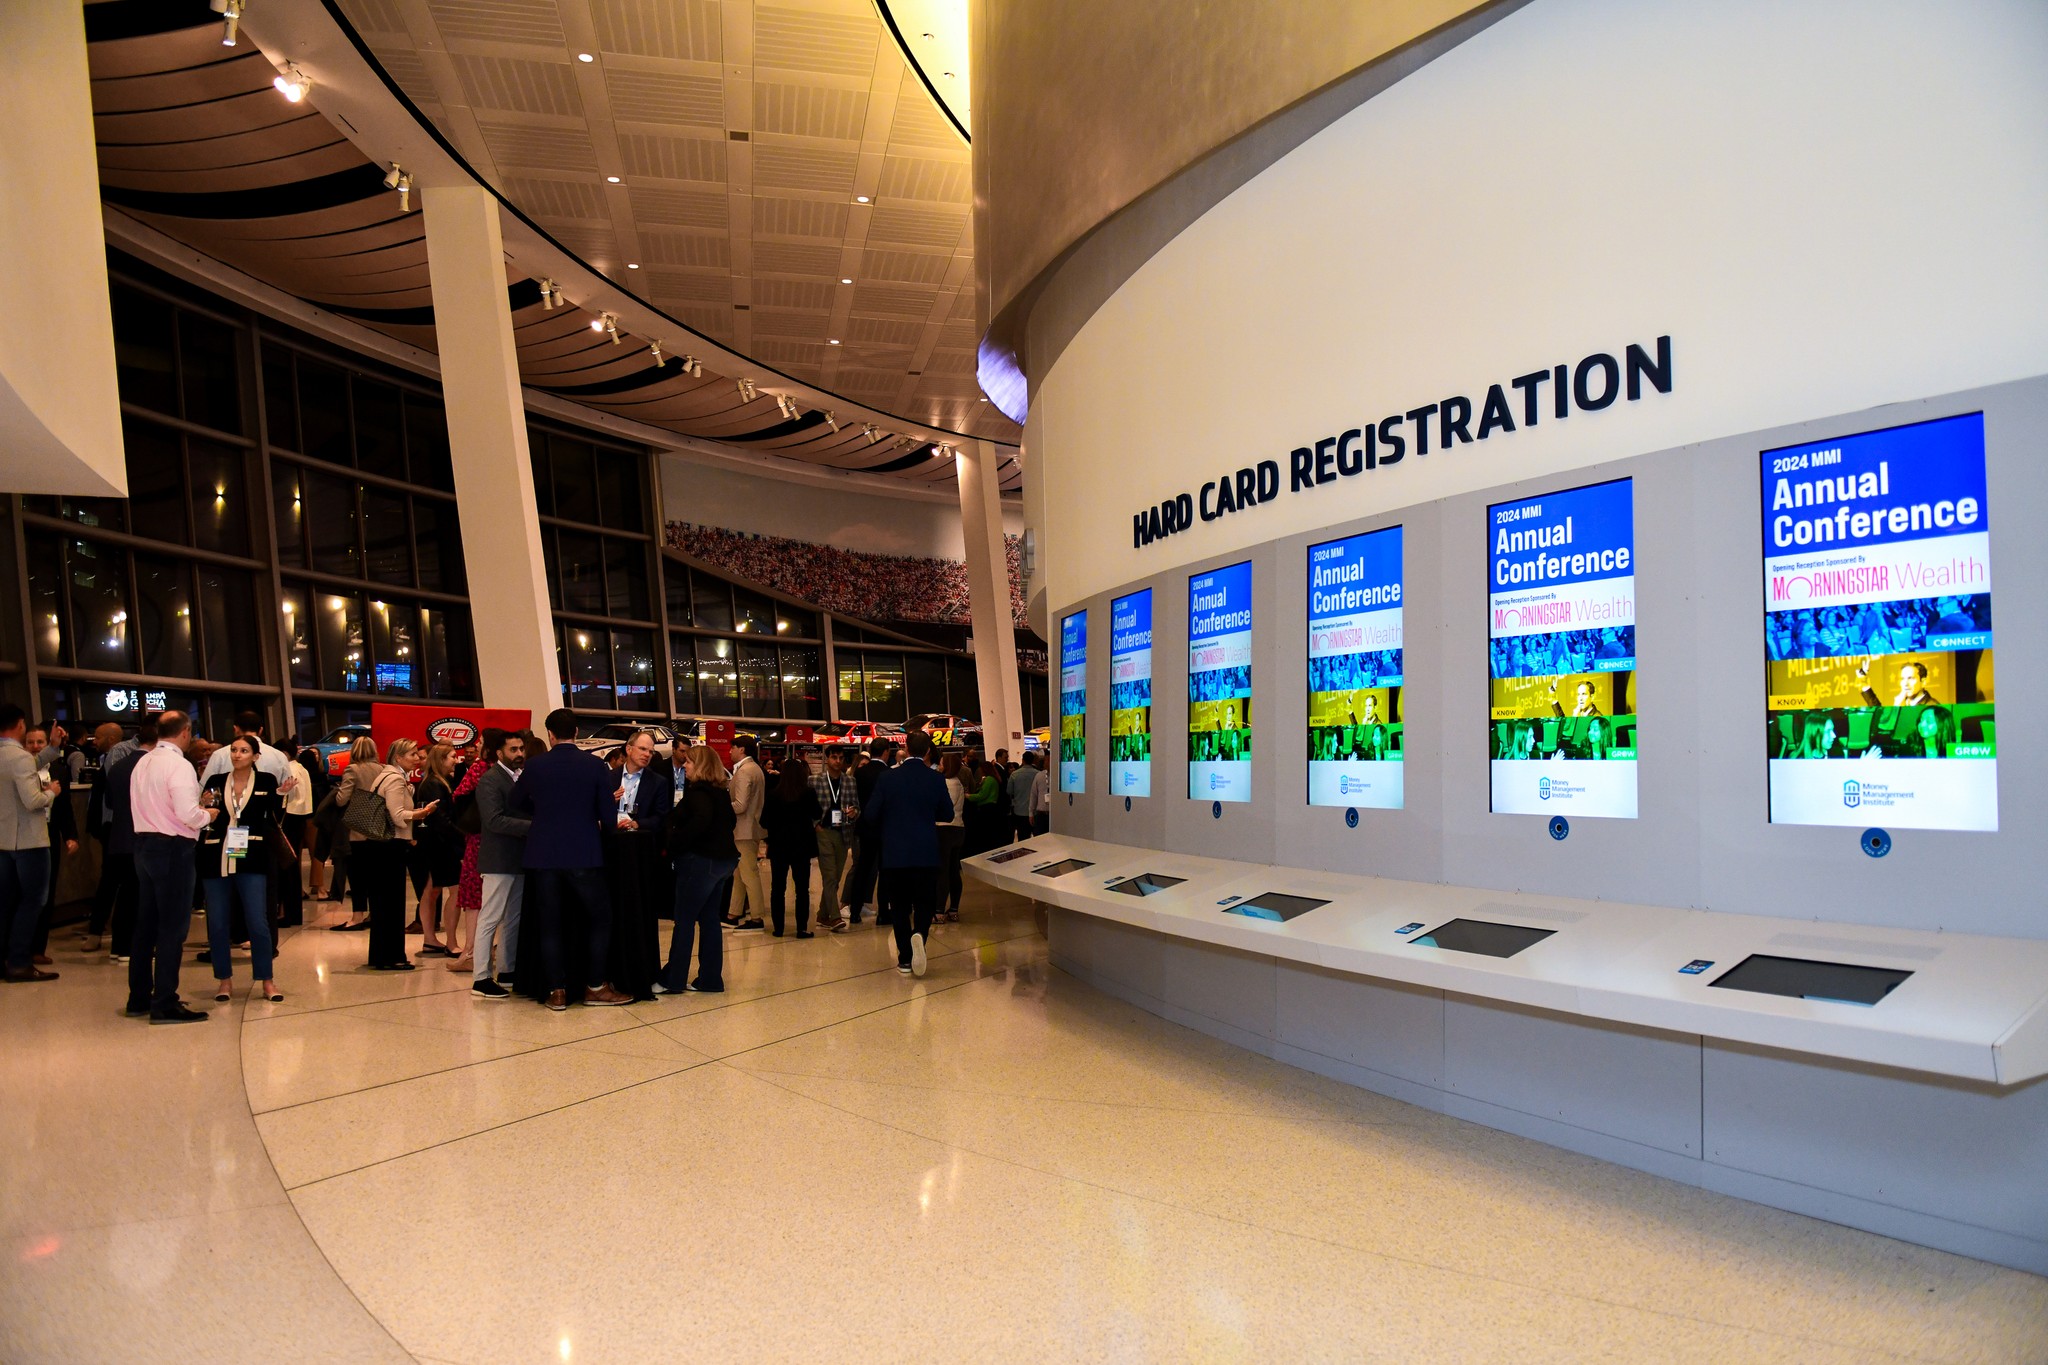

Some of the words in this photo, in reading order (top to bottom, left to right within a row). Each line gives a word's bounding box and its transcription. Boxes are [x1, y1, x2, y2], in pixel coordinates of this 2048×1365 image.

[1133, 492, 1193, 549] HARD
[1199, 459, 1279, 522] CARD
[1290, 335, 1673, 493] REGISTRATION
[1773, 454, 1809, 473] 2024
[1811, 448, 1842, 467] MMI
[1772, 461, 1889, 510] Annual
[1496, 509, 1520, 524] 2024
[1522, 504, 1542, 520] MMI
[1773, 496, 1979, 548] Conference
[1496, 516, 1573, 555] Annual
[1314, 549, 1329, 562] 2024
[1330, 546, 1344, 558] MMI
[1772, 563, 1795, 573] Opening
[1796, 559, 1825, 570] Reception
[1826, 557, 1857, 567] Sponsored
[1858, 555, 1866, 563] By
[1313, 556, 1364, 588] Annual
[1496, 547, 1630, 585] Conference
[1773, 565, 1889, 601] MORNINGSTAR
[1895, 556, 1984, 589] Wealth
[1192, 586, 1227, 613] Annual
[1313, 583, 1401, 614] Conference
[1495, 598, 1510, 606] Opening
[1511, 596, 1530, 605] Reception
[1530, 593, 1551, 602] Sponsored
[1113, 609, 1136, 632] Annual
[1192, 609, 1251, 635] Conference
[1495, 601, 1571, 630] MORNINGSTAR
[1574, 595, 1632, 622] Wealth
[1113, 629, 1152, 651] Conference
[1364, 624, 1402, 645] Wealth
[1933, 636, 1986, 648] CONNECT
[1599, 660, 1633, 669] CONNECT
[1777, 698, 1806, 707] KNOW
[435, 727, 470, 740] 40
[931, 730, 953, 746] 24
[1955, 746, 1990, 756] GROW
[1552, 785, 1585, 793] Management
[1863, 782, 1889, 792] Money
[1863, 790, 1914, 800] Management
[1863, 798, 1895, 806] Institute
